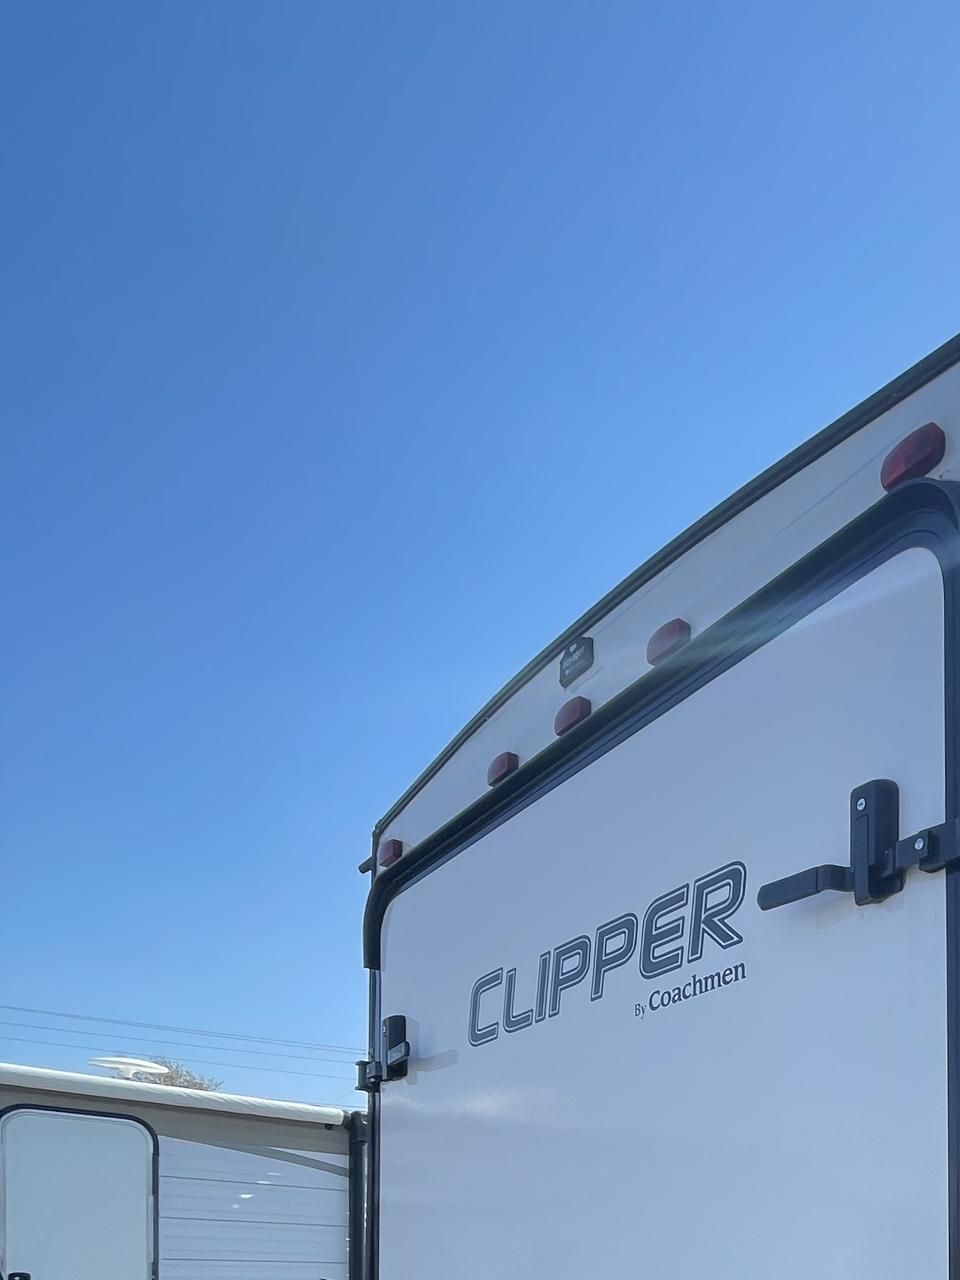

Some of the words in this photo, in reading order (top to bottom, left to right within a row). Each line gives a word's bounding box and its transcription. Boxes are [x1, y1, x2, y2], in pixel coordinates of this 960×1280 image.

[468, 860, 747, 1048] CLIPPER
[634, 1003, 647, 1019] By
[649, 962, 746, 1012] Coachmen
